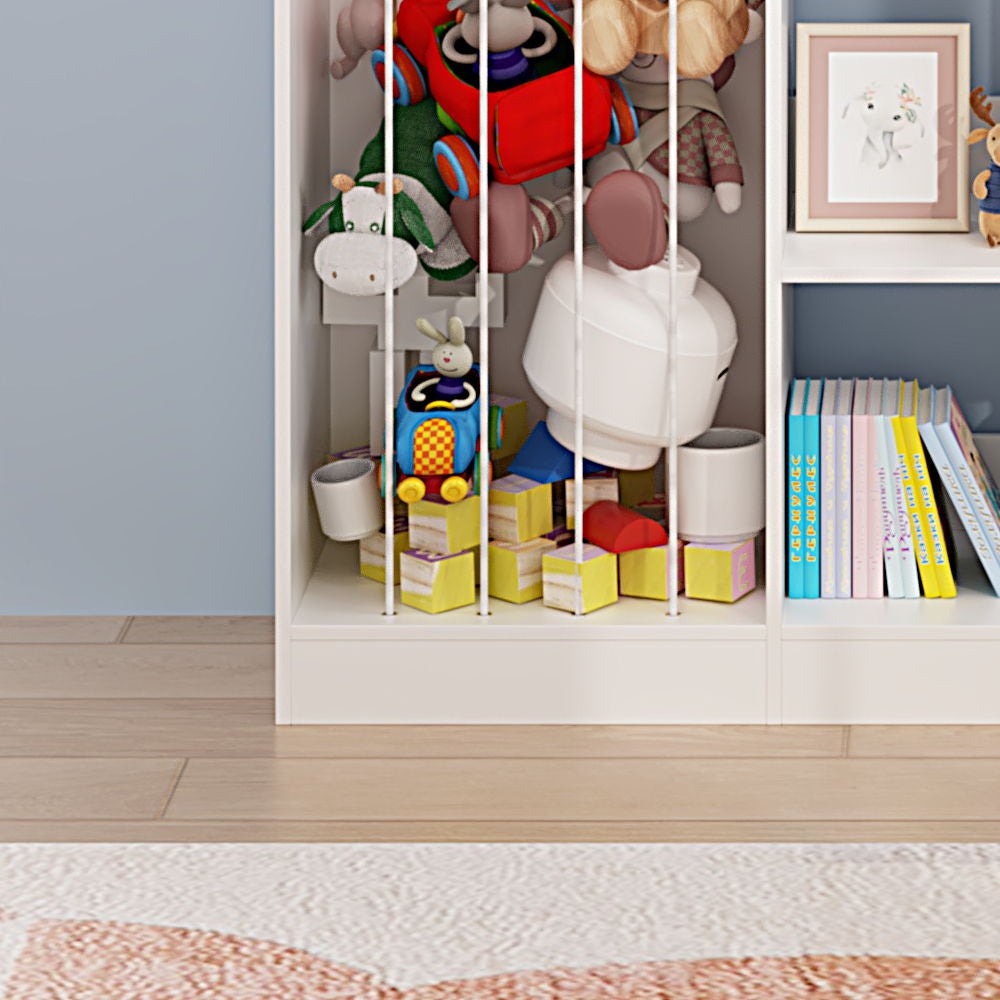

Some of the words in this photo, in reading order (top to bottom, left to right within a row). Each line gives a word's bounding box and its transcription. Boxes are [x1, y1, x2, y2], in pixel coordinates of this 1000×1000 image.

[905, 485, 916, 509] на
[920, 485, 931, 509] на
[911, 513, 929, 565] Казки
[927, 513, 945, 565] Казки
